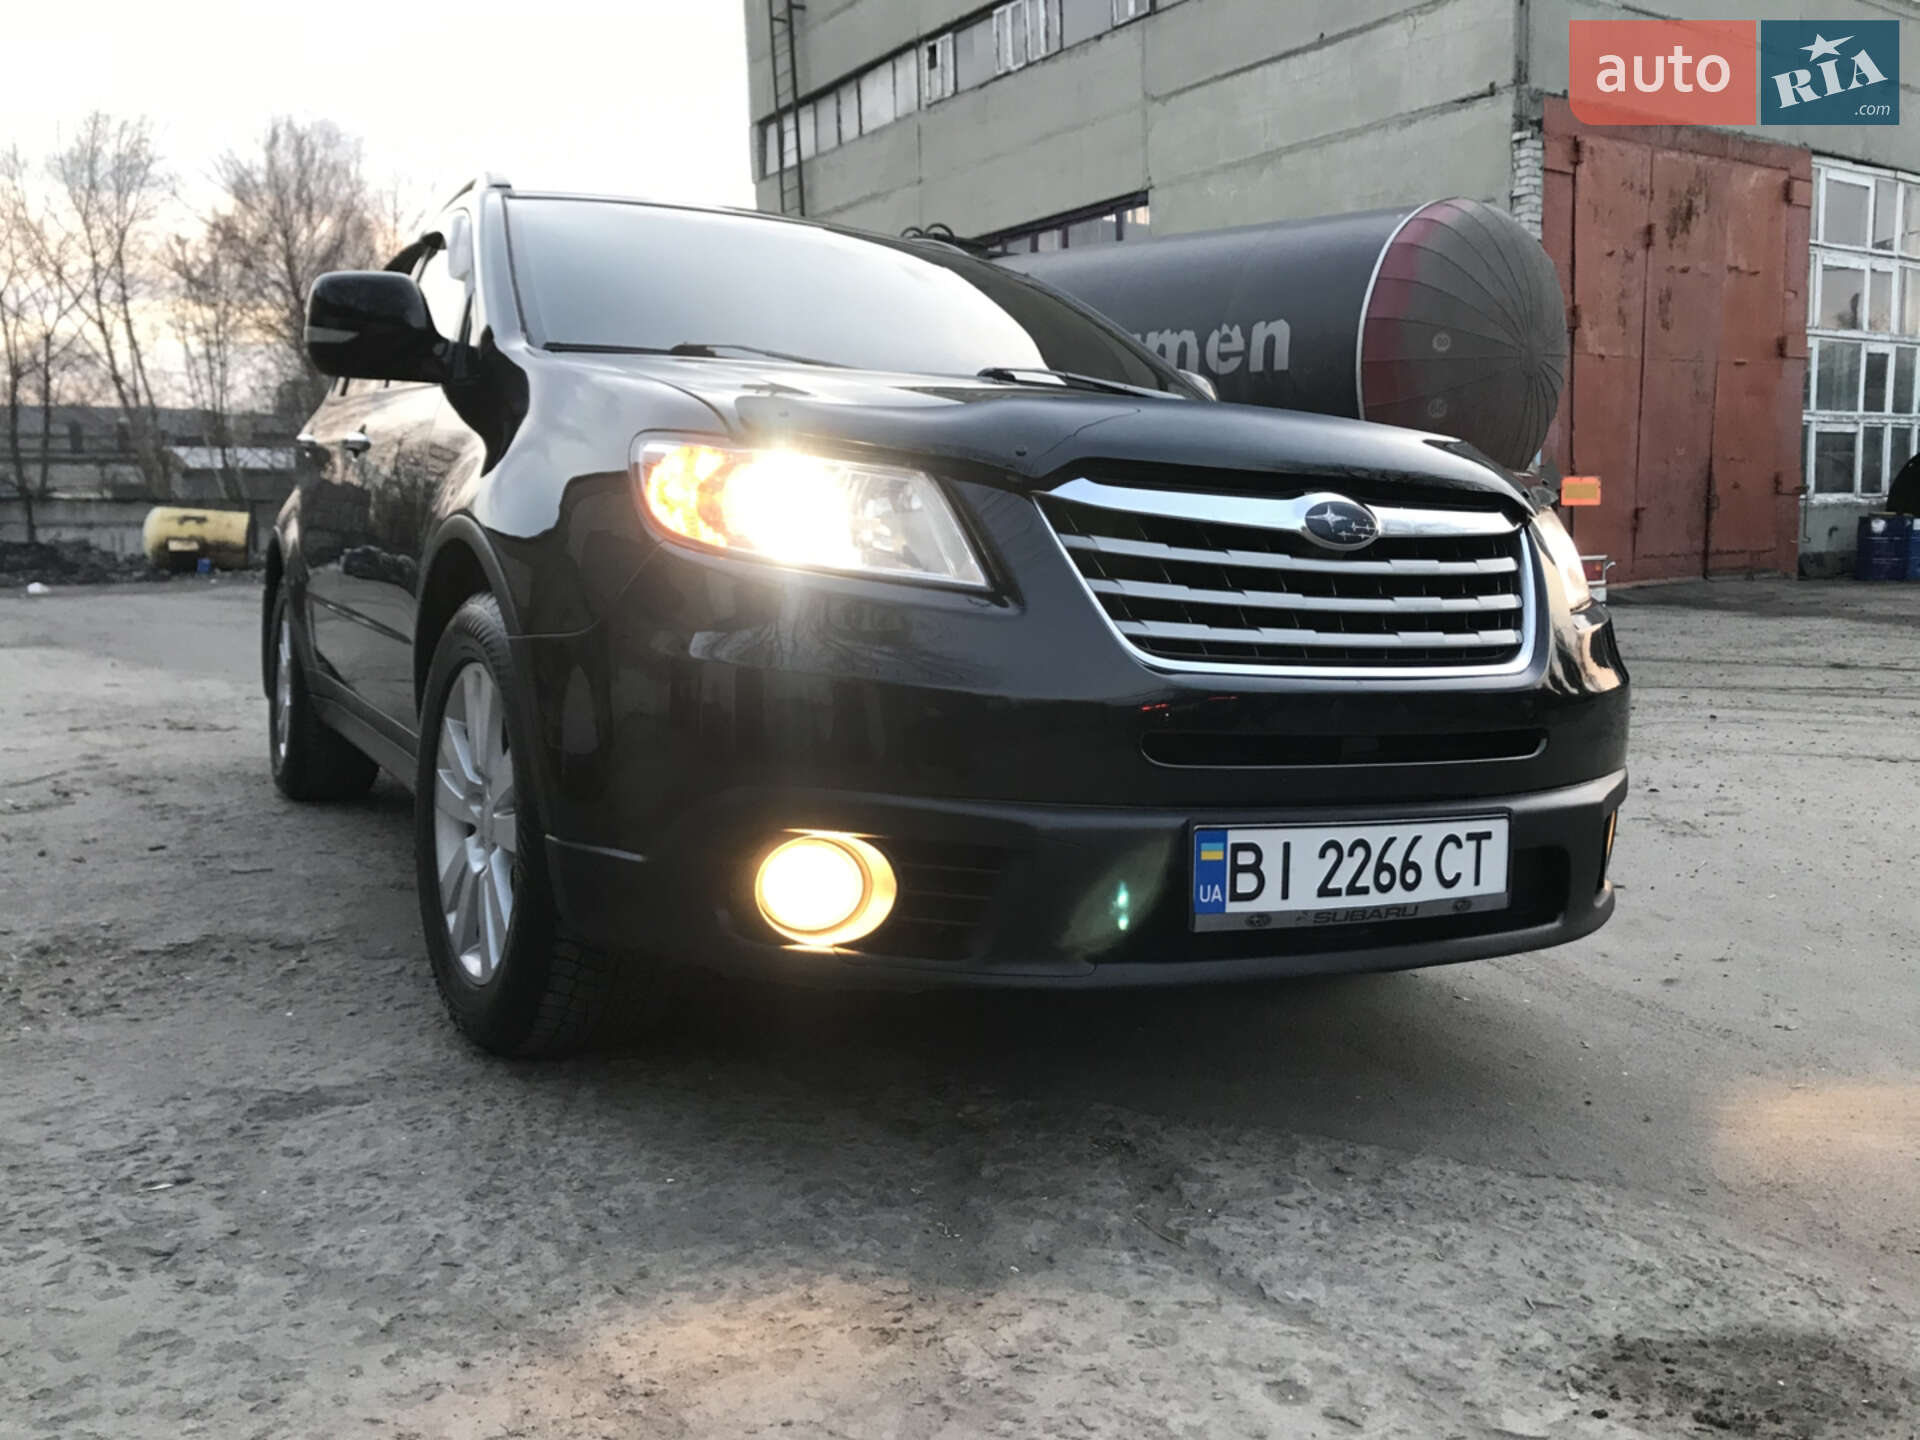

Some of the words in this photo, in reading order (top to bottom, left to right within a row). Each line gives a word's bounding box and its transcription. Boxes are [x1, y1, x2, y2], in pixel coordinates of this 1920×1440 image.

[1229, 841, 1291, 902] BI
[1316, 835, 1423, 898] 2266
[1435, 831, 1492, 889] CT
[1200, 885, 1223, 903] UA
[1314, 905, 1419, 924] SUBARU
